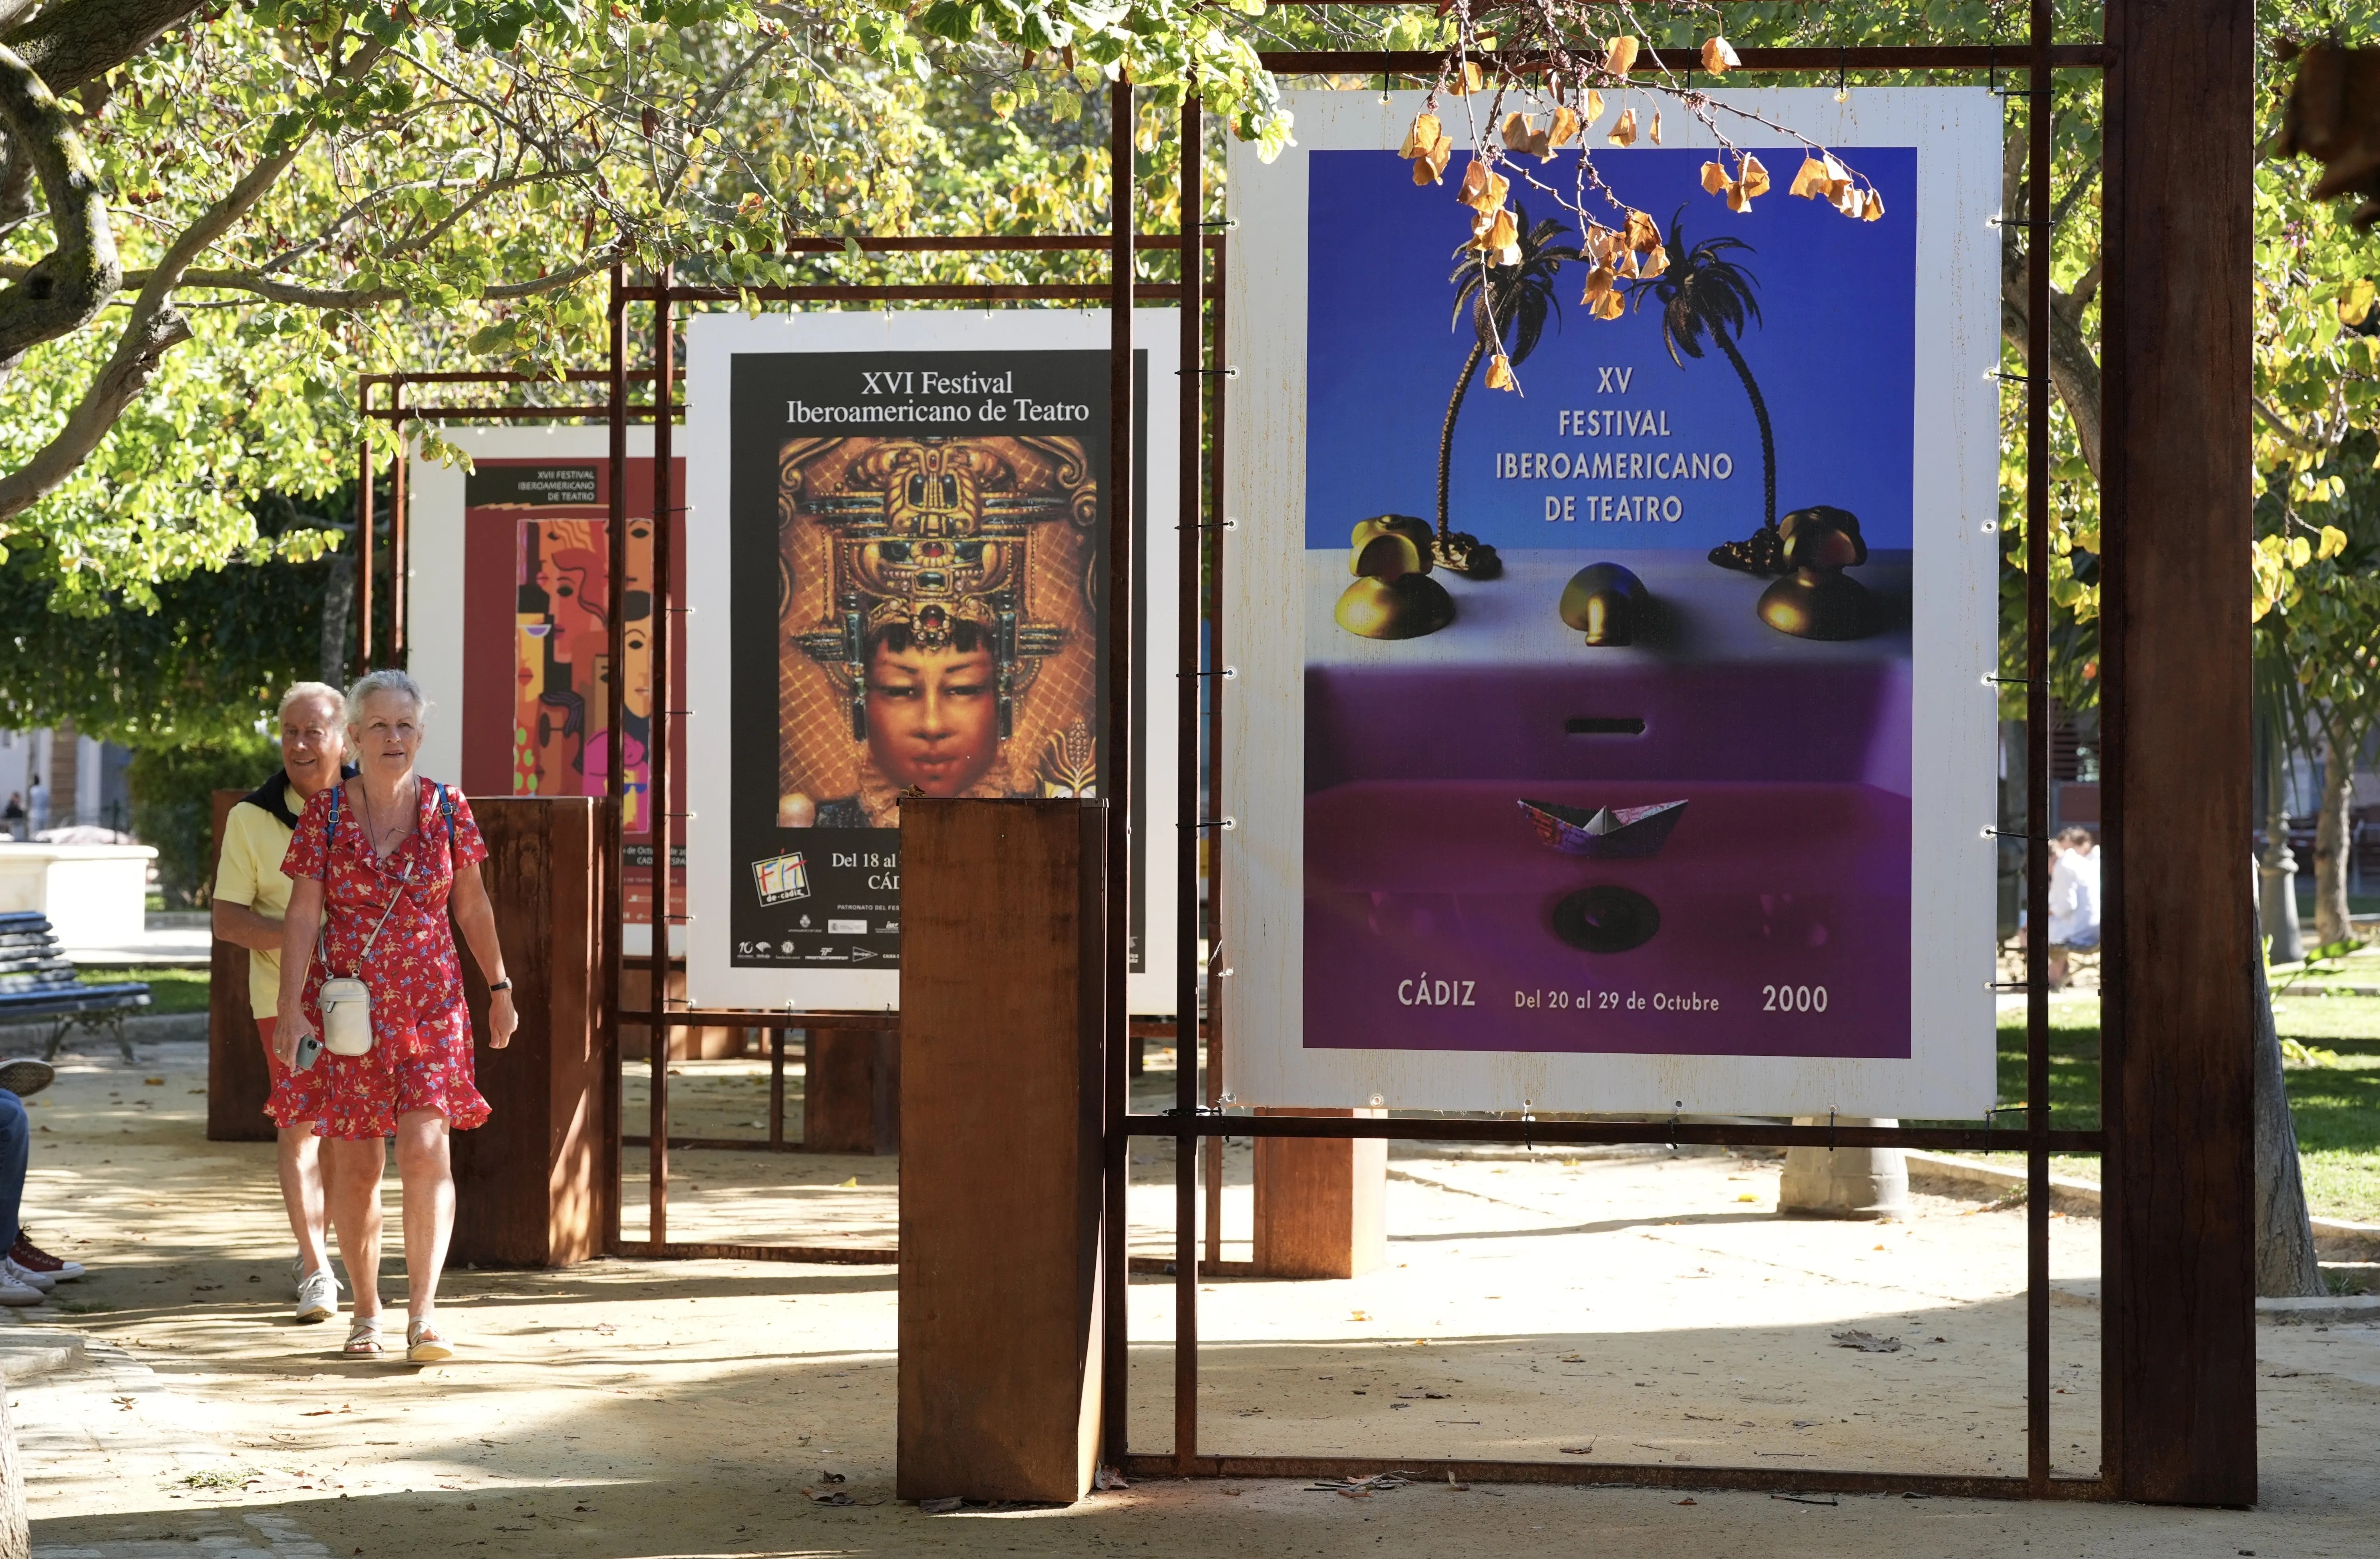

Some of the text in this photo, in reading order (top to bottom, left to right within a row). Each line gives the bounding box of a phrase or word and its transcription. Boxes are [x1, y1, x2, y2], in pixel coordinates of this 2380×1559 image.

[861, 371, 1013, 394] XVI Festival
[1597, 366, 1633, 394] XV
[787, 398, 1090, 423] Iberoamericano de Teatro
[1559, 409, 1671, 437] FESTIVAL
[537, 470, 595, 479] XVII FESTIVAL
[1496, 452, 1733, 480] IBEROAMERICANO
[518, 481, 595, 490] IBEROAMERICANO
[547, 492, 595, 501] DE TEATRO
[1545, 495, 1683, 522] DE TEATRO
[832, 853, 896, 868] Del 18 al
[868, 872, 899, 890] CÁD
[1398, 971, 1476, 1006] CÁDIZ
[1515, 989, 1719, 1011] Del 20 al 29 de Octubre
[1762, 985, 1828, 1013] 2000
